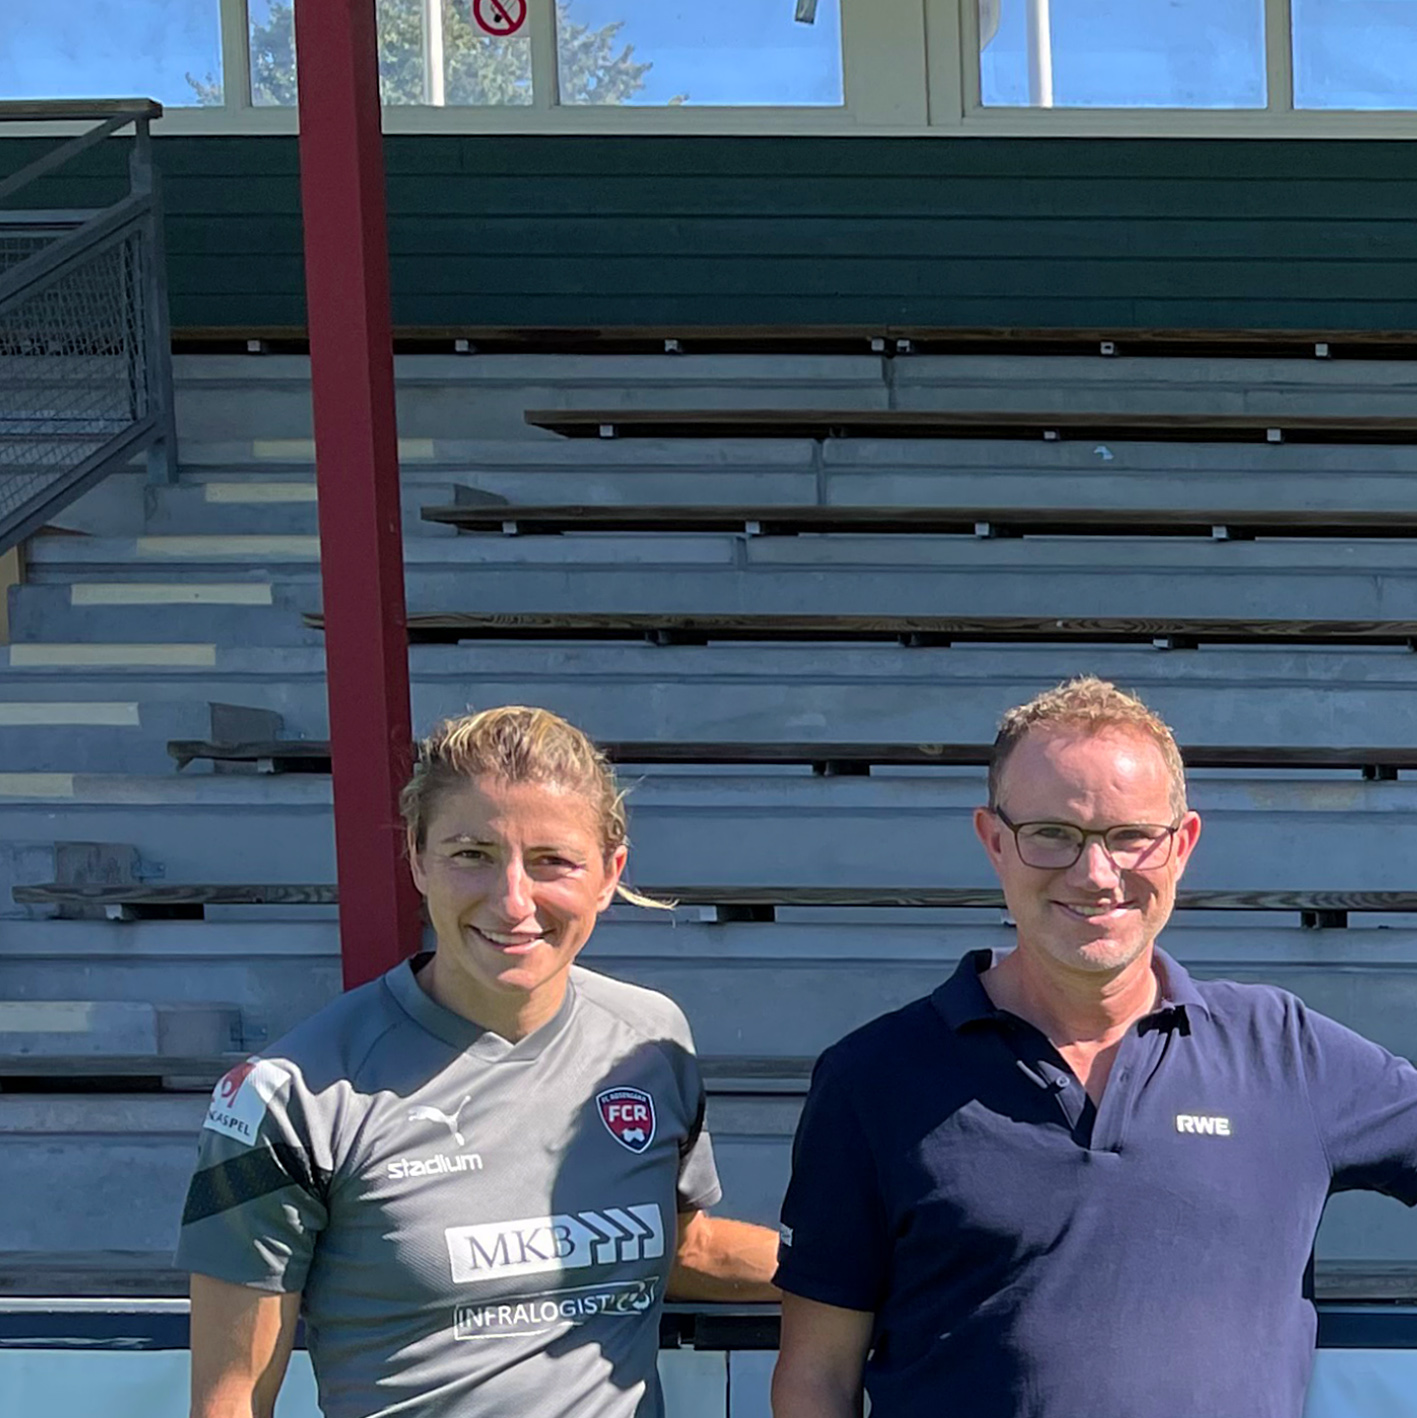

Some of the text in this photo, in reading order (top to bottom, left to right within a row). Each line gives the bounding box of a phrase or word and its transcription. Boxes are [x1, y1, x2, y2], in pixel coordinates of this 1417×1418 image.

[608, 1104, 648, 1122] FCR
[1176, 1114, 1231, 1136] RWE
[387, 1153, 483, 1179] stadium
[466, 1224, 577, 1271] MKB
